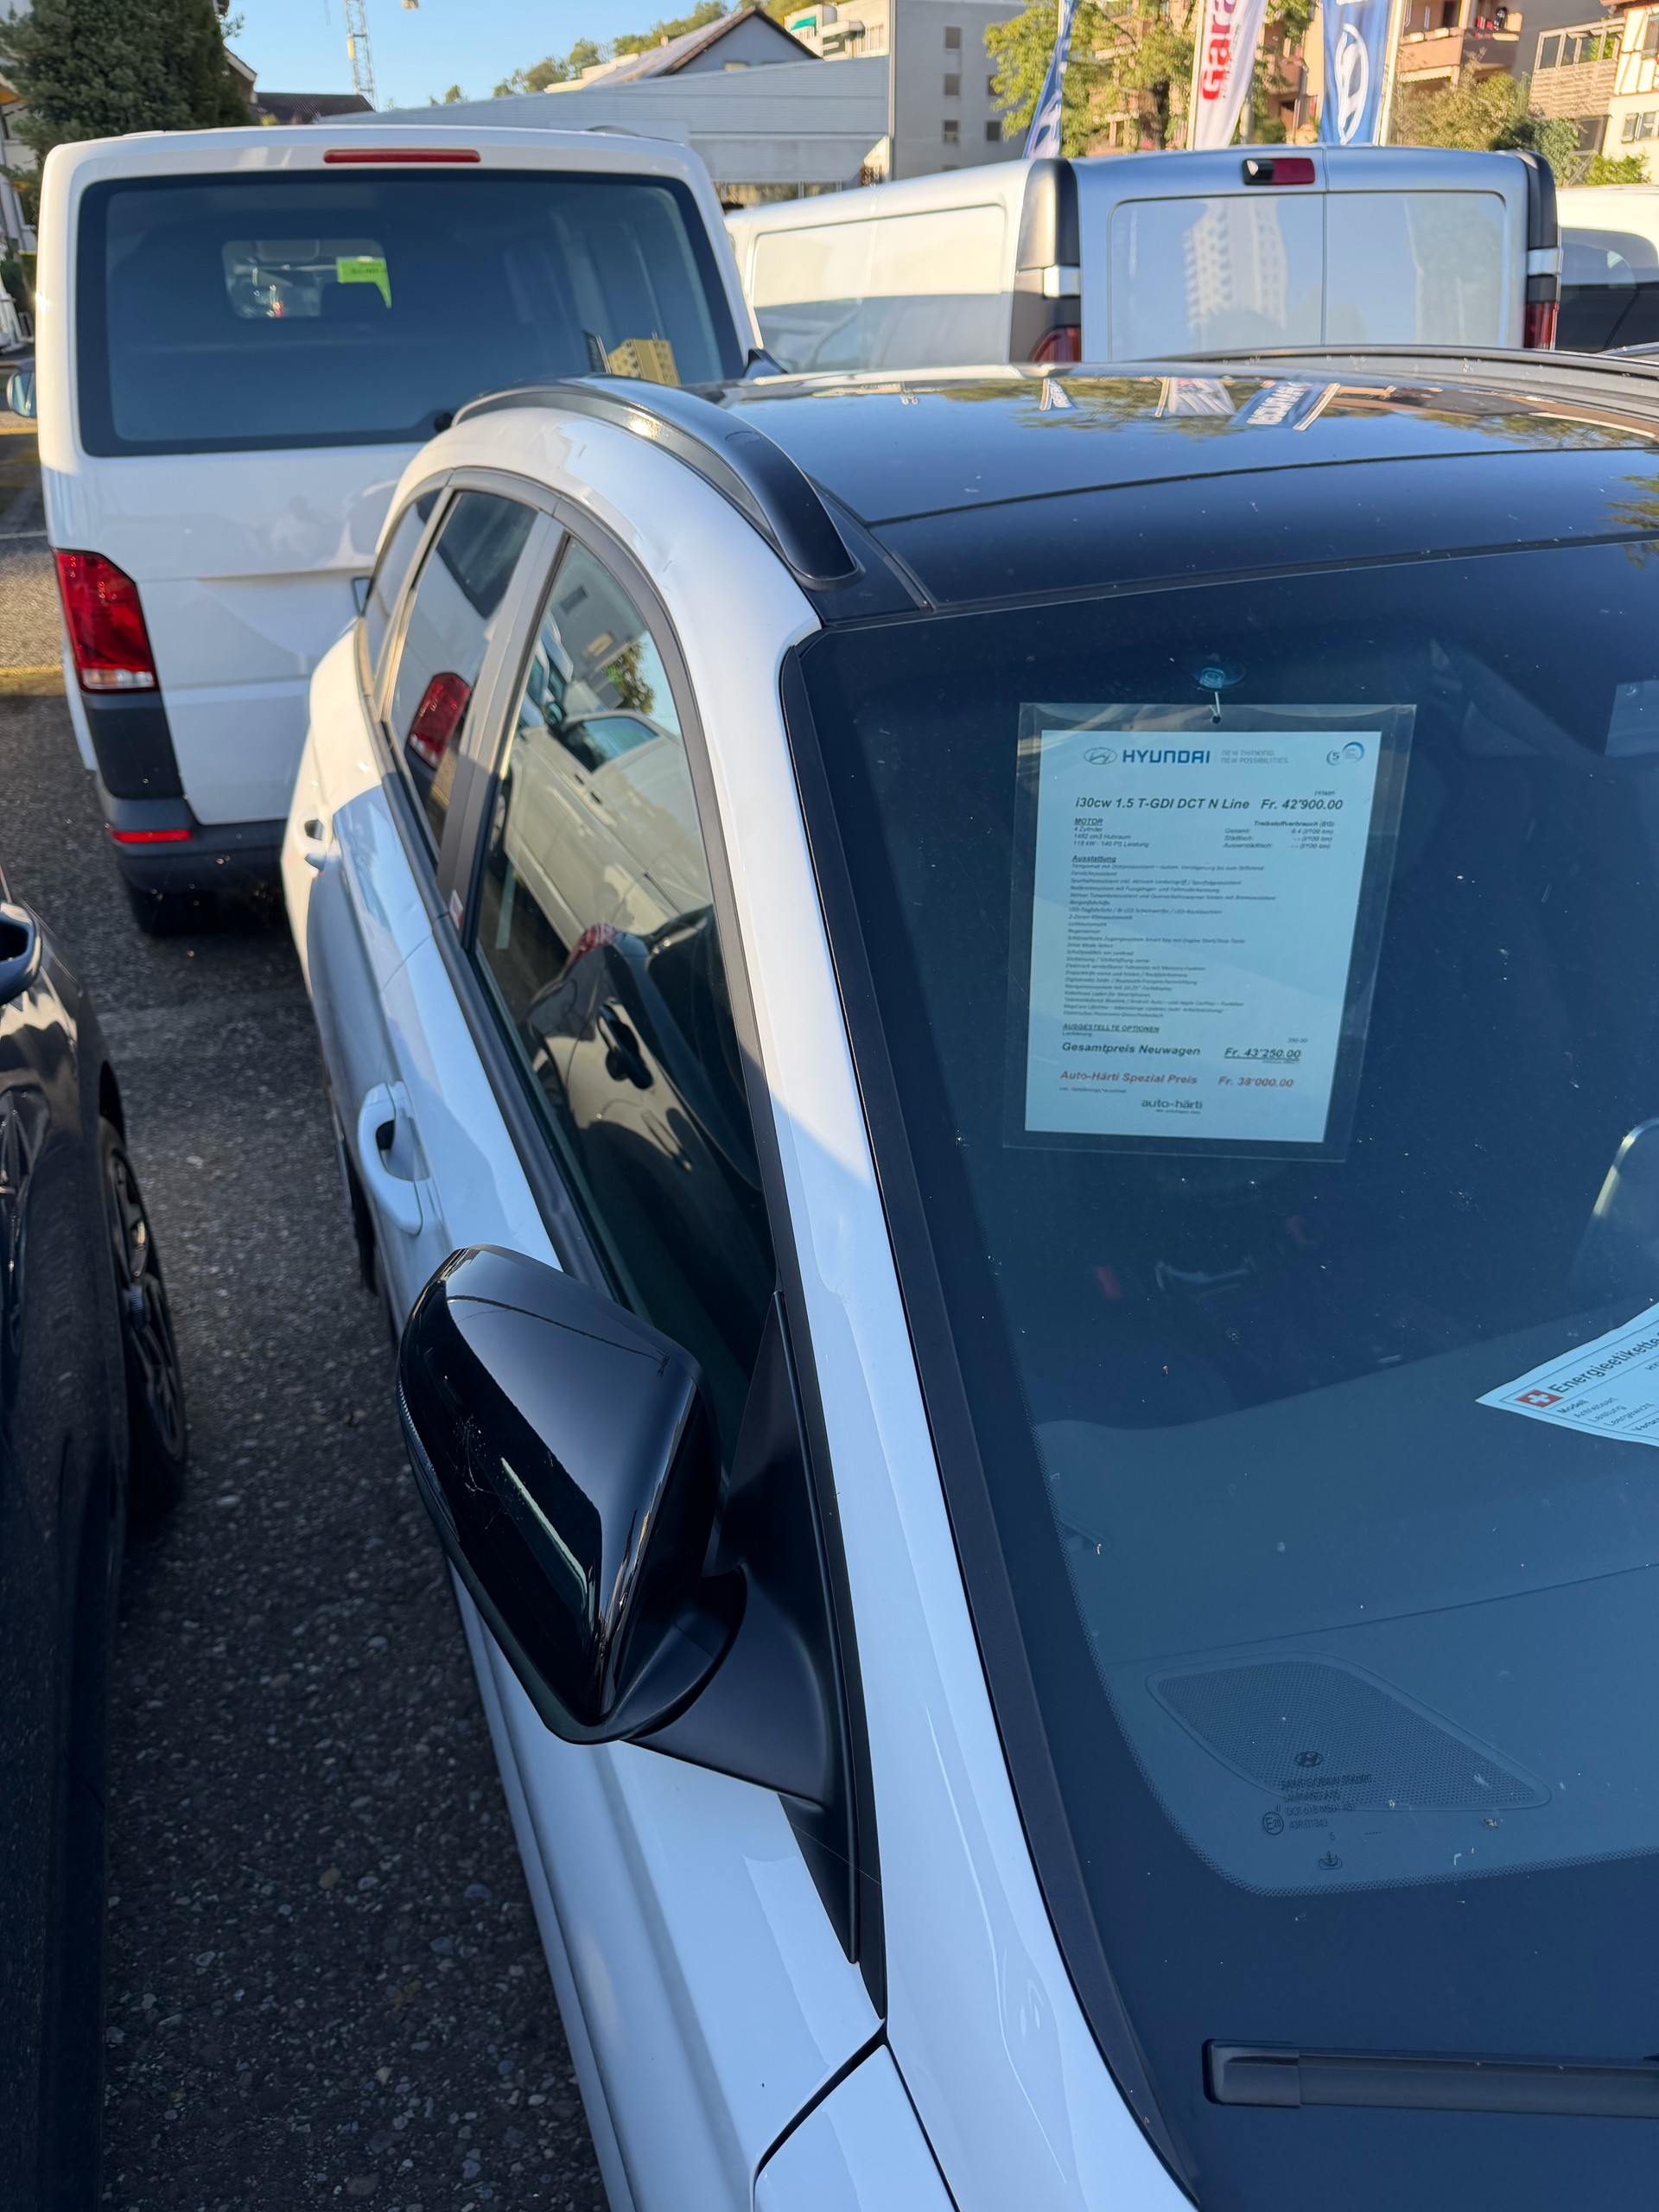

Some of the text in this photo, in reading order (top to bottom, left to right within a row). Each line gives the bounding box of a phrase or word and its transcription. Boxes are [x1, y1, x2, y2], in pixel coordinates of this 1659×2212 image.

[1122, 750, 1211, 764] HYUNDAI
[1075, 797, 1250, 810] i30cw 1.5 T-GDI DCT N Line
[1260, 798, 1344, 810] Fr. 42'900.00
[1071, 855, 1117, 863] Ausstattung
[1121, 1025, 1160, 1034] OPTIONEN
[1061, 1041, 1201, 1058] Gesamtpreis Neuwagen
[1224, 1047, 1301, 1059] Fr. 43'250.00
[1059, 1071, 1198, 1085] Auto-Härti Spezial Preis
[1217, 1076, 1294, 1088] Fr. 38'000.00
[1141, 1098, 1203, 1109] auto-härti
[1548, 1337, 1659, 1393] Energieetikette
